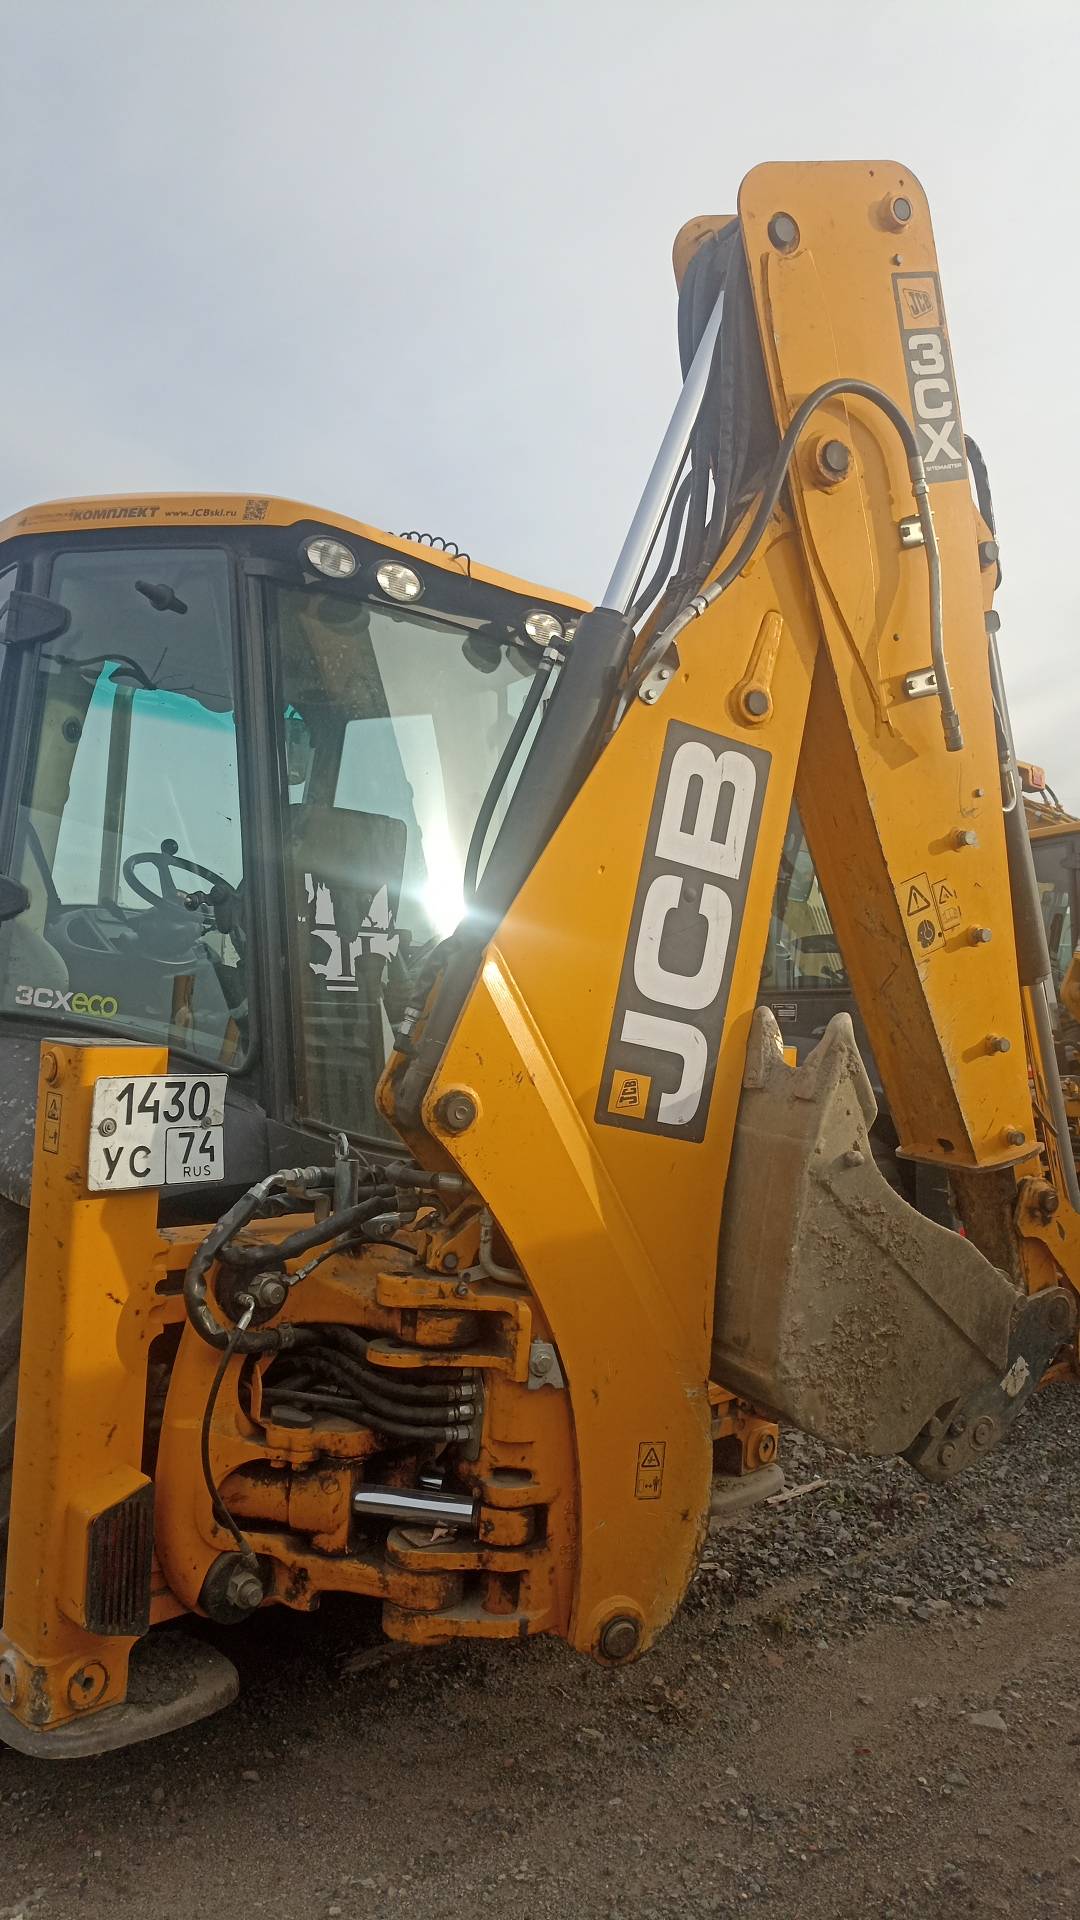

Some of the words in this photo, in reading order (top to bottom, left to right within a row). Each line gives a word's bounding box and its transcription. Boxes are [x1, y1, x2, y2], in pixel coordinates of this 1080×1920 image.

[908, 291, 933, 315] JCB
[908, 333, 963, 463] 3CX
[620, 741, 757, 1125] JCB
[116, 1081, 211, 1125] 1430
[619, 1080, 638, 1105] JCB
[178, 1131, 215, 1164] 74
[183, 1164, 212, 1177] RUS
